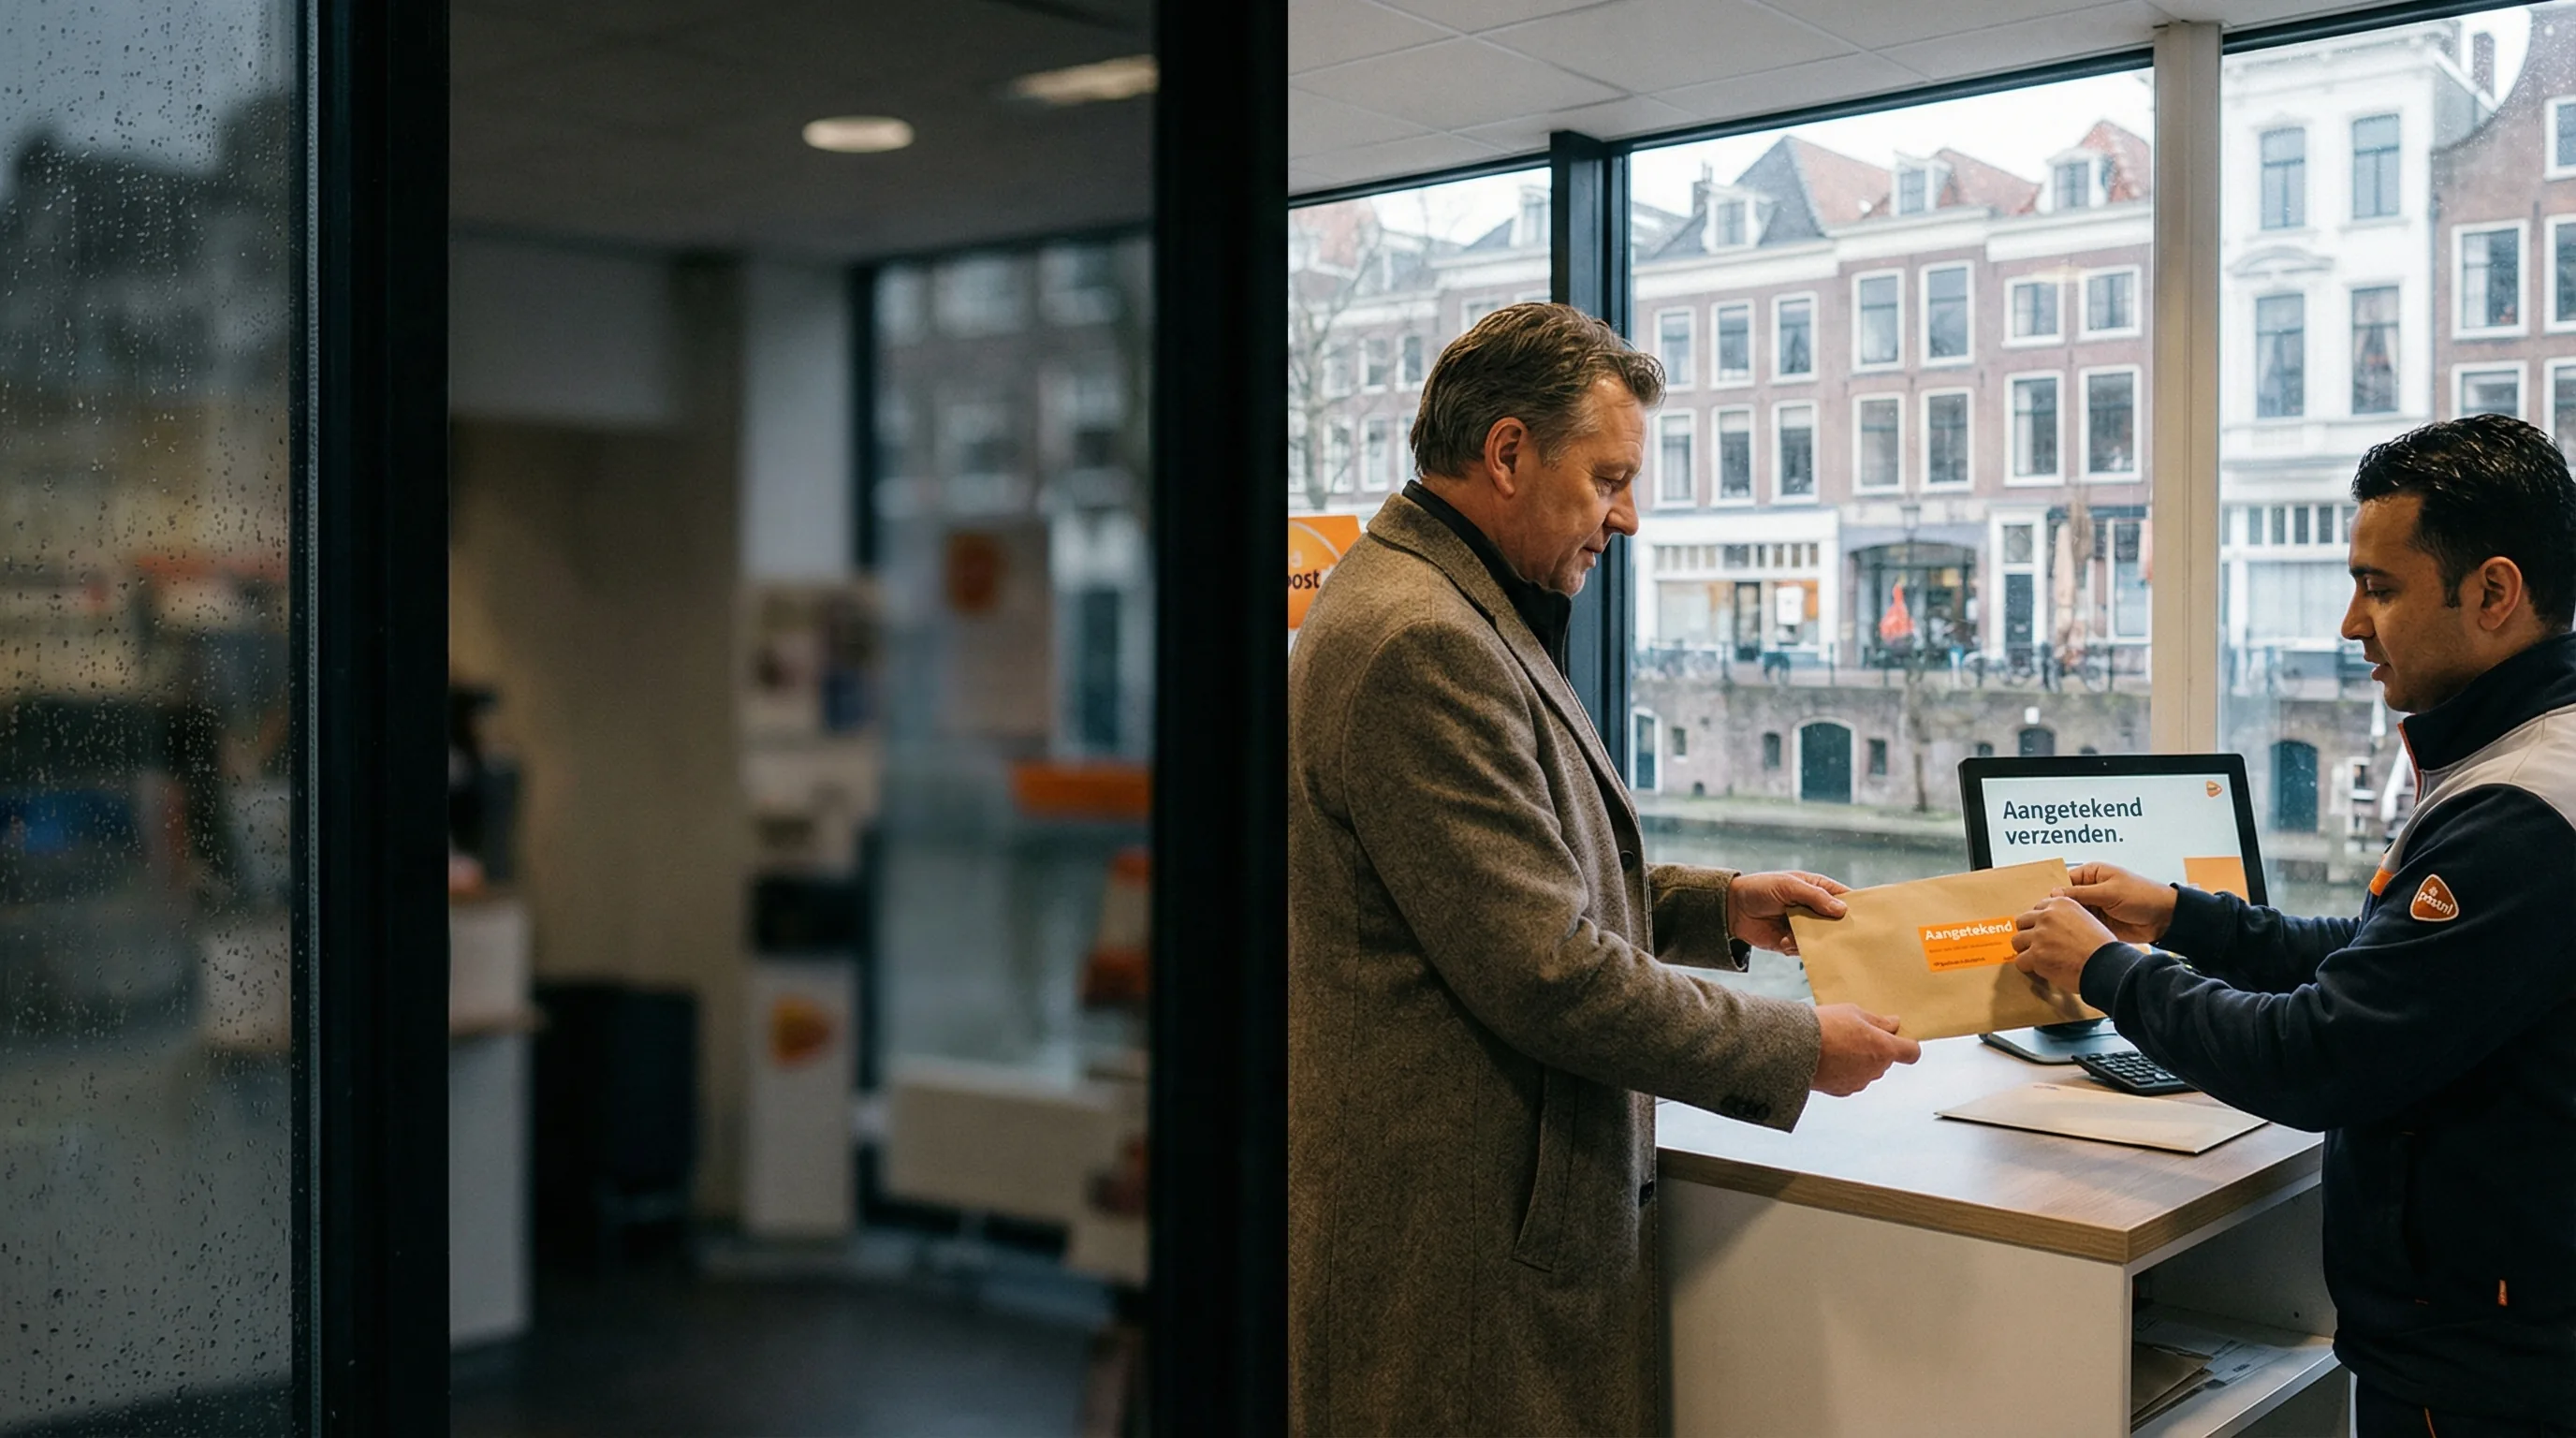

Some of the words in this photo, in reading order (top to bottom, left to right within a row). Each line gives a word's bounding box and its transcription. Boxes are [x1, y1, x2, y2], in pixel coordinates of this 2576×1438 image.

[2003, 797, 2143, 825] Aangetekend
[2005, 824, 2124, 844] verzenden.
[1925, 920, 2013, 941] Aangetekend
